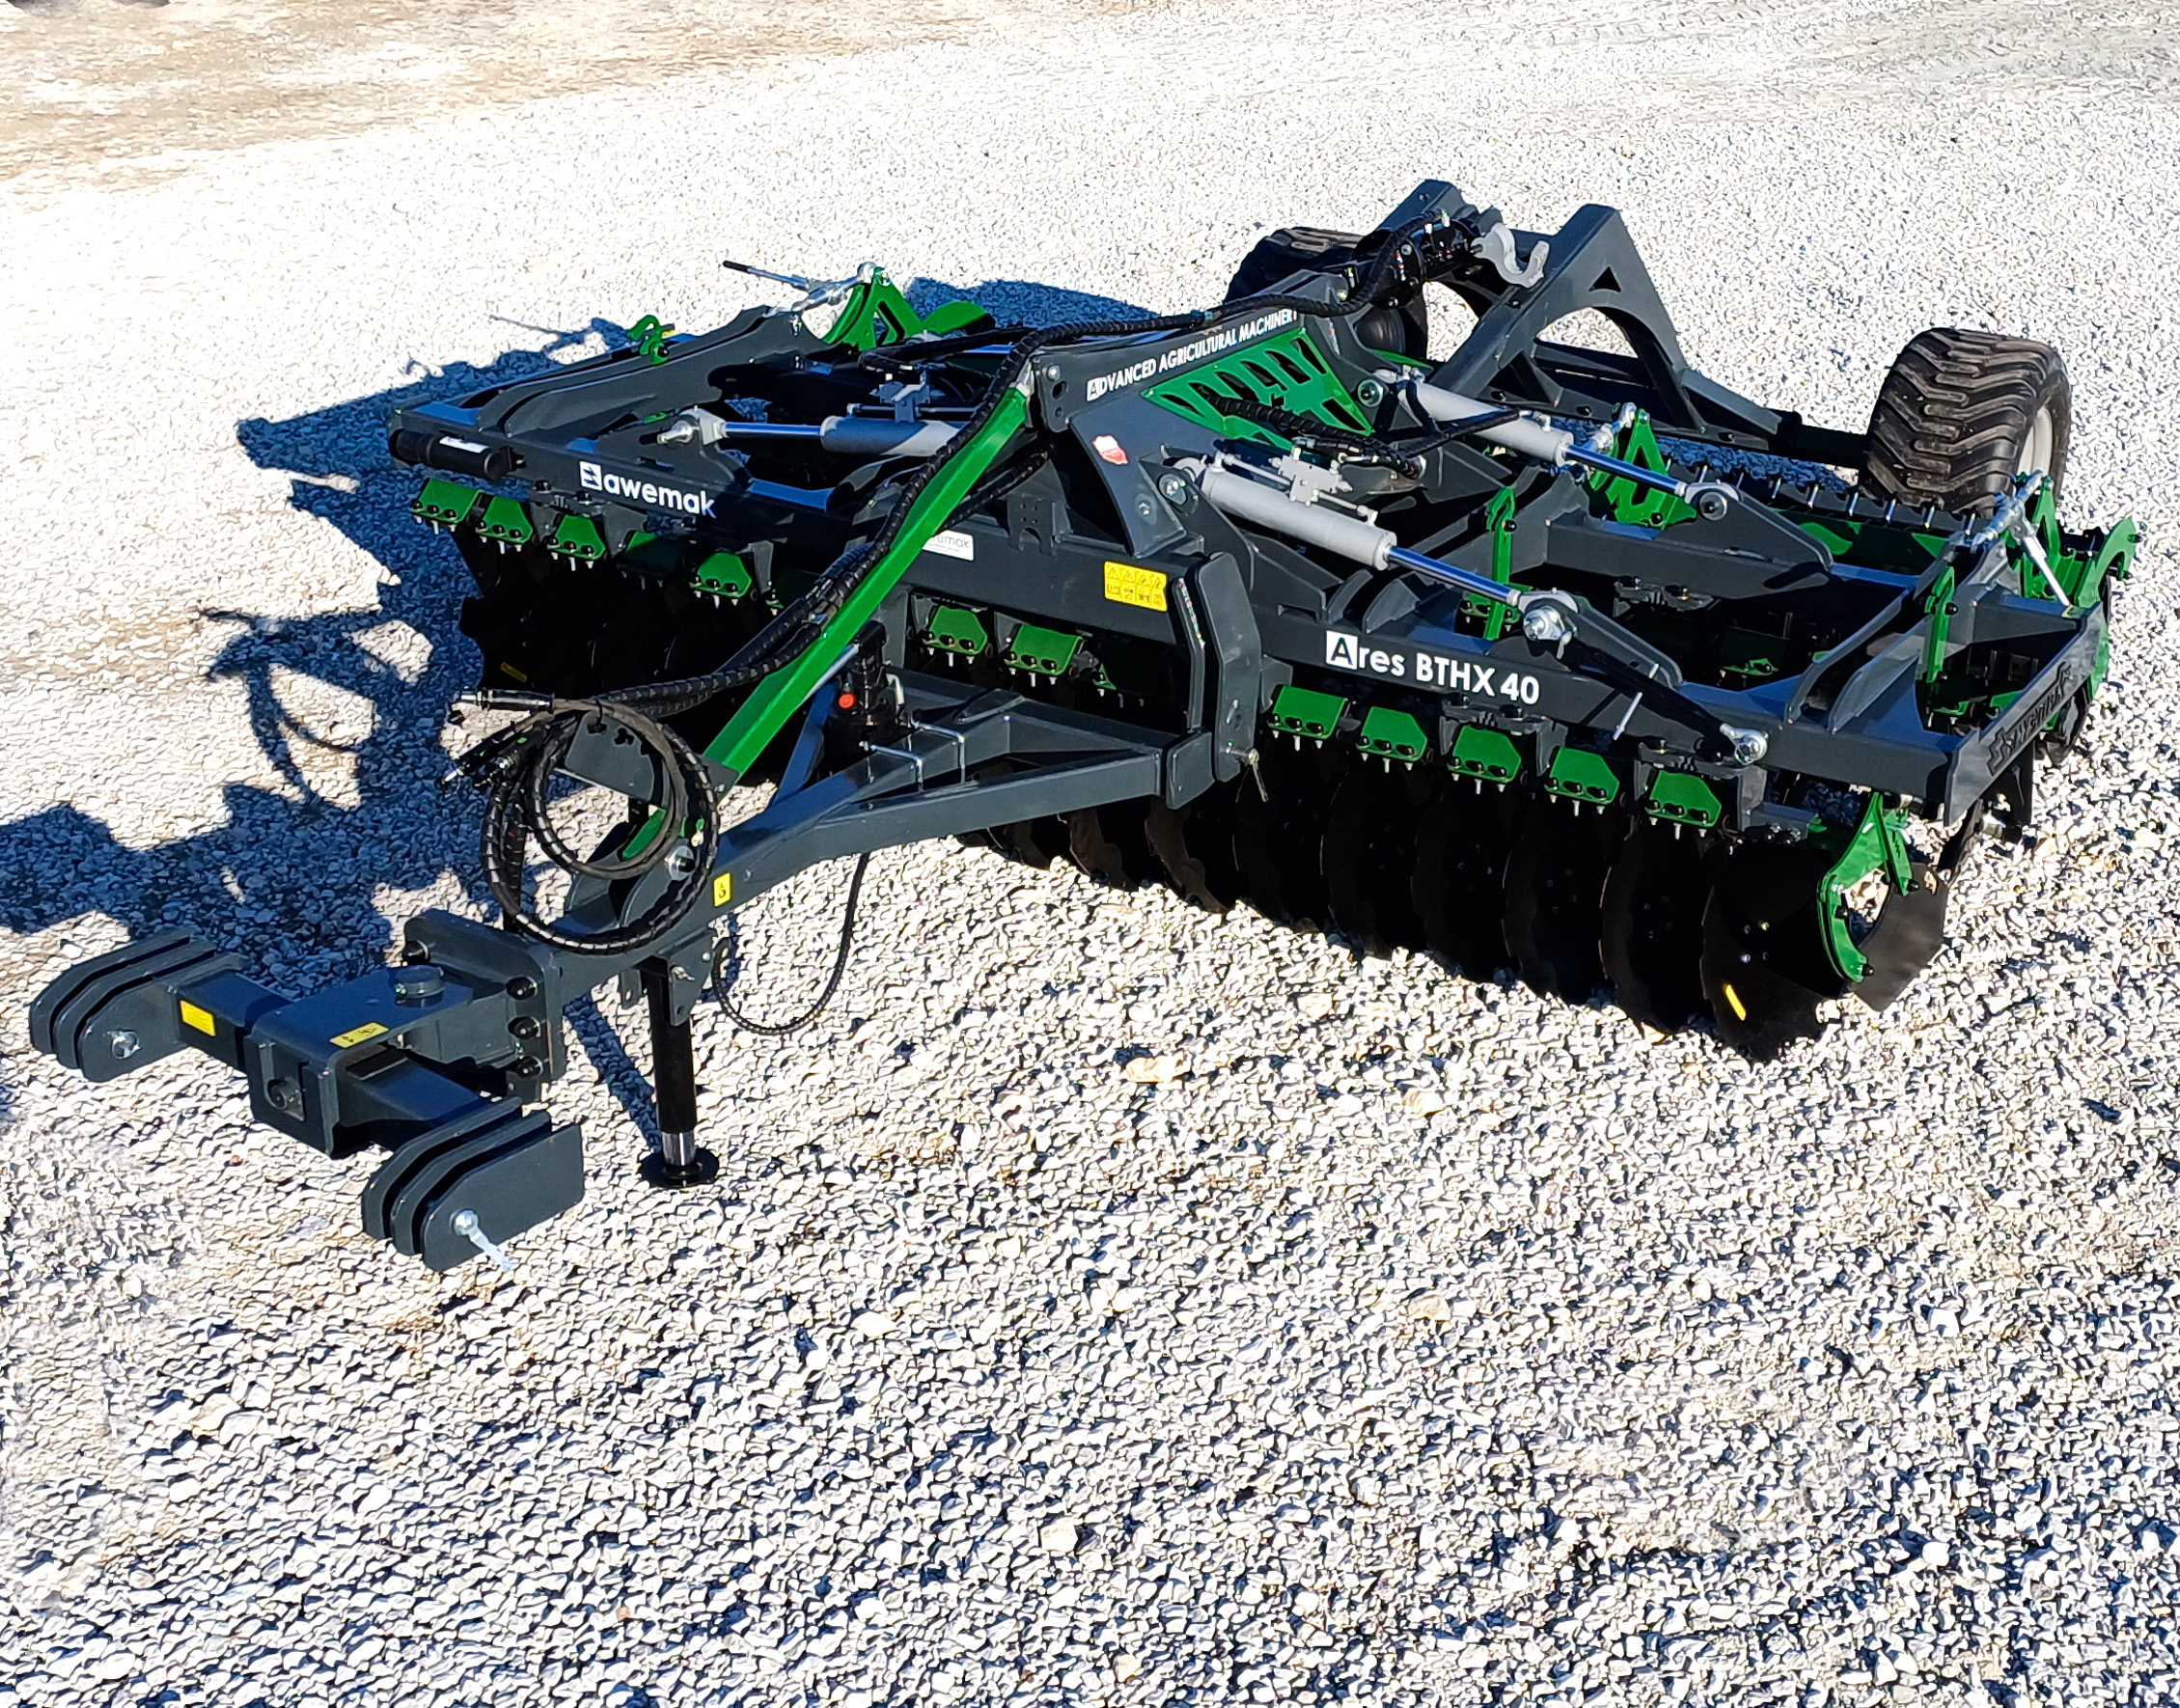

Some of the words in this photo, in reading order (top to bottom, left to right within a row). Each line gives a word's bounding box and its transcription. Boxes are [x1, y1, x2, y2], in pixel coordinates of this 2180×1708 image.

[1087, 358, 1156, 401] ADVANCED
[1158, 328, 1238, 373] AGRICULTURAL
[1326, 630, 1405, 676] Ares
[1416, 652, 1495, 697] BTHX
[1500, 673, 1539, 704] 40
